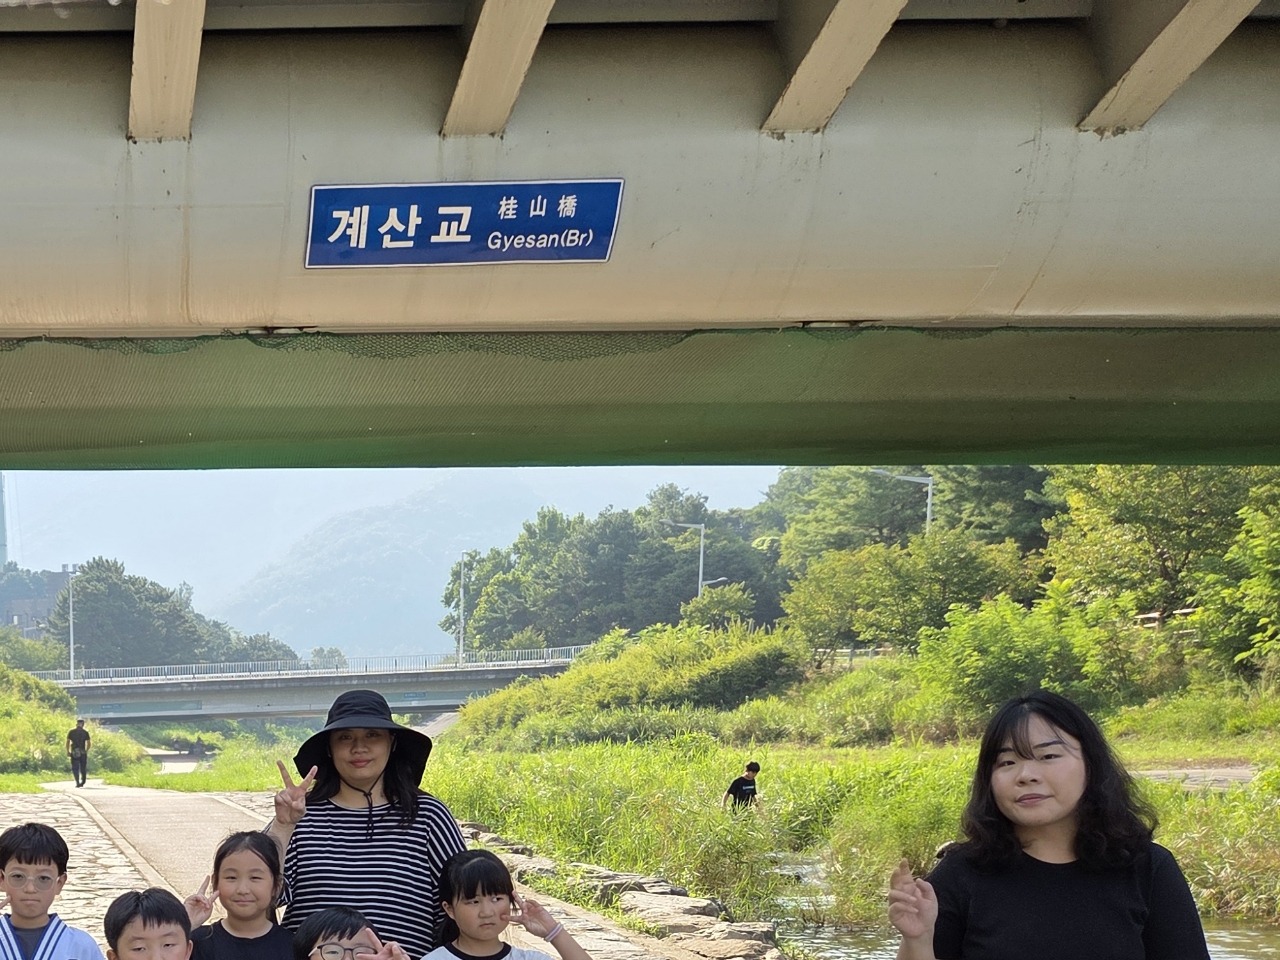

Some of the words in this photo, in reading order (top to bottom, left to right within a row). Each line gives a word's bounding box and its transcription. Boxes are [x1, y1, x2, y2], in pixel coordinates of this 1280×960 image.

[497, 195, 578, 220] 桂山橋
[328, 204, 472, 249] 계산교
[487, 229, 594, 251] Gyesan(Br)
